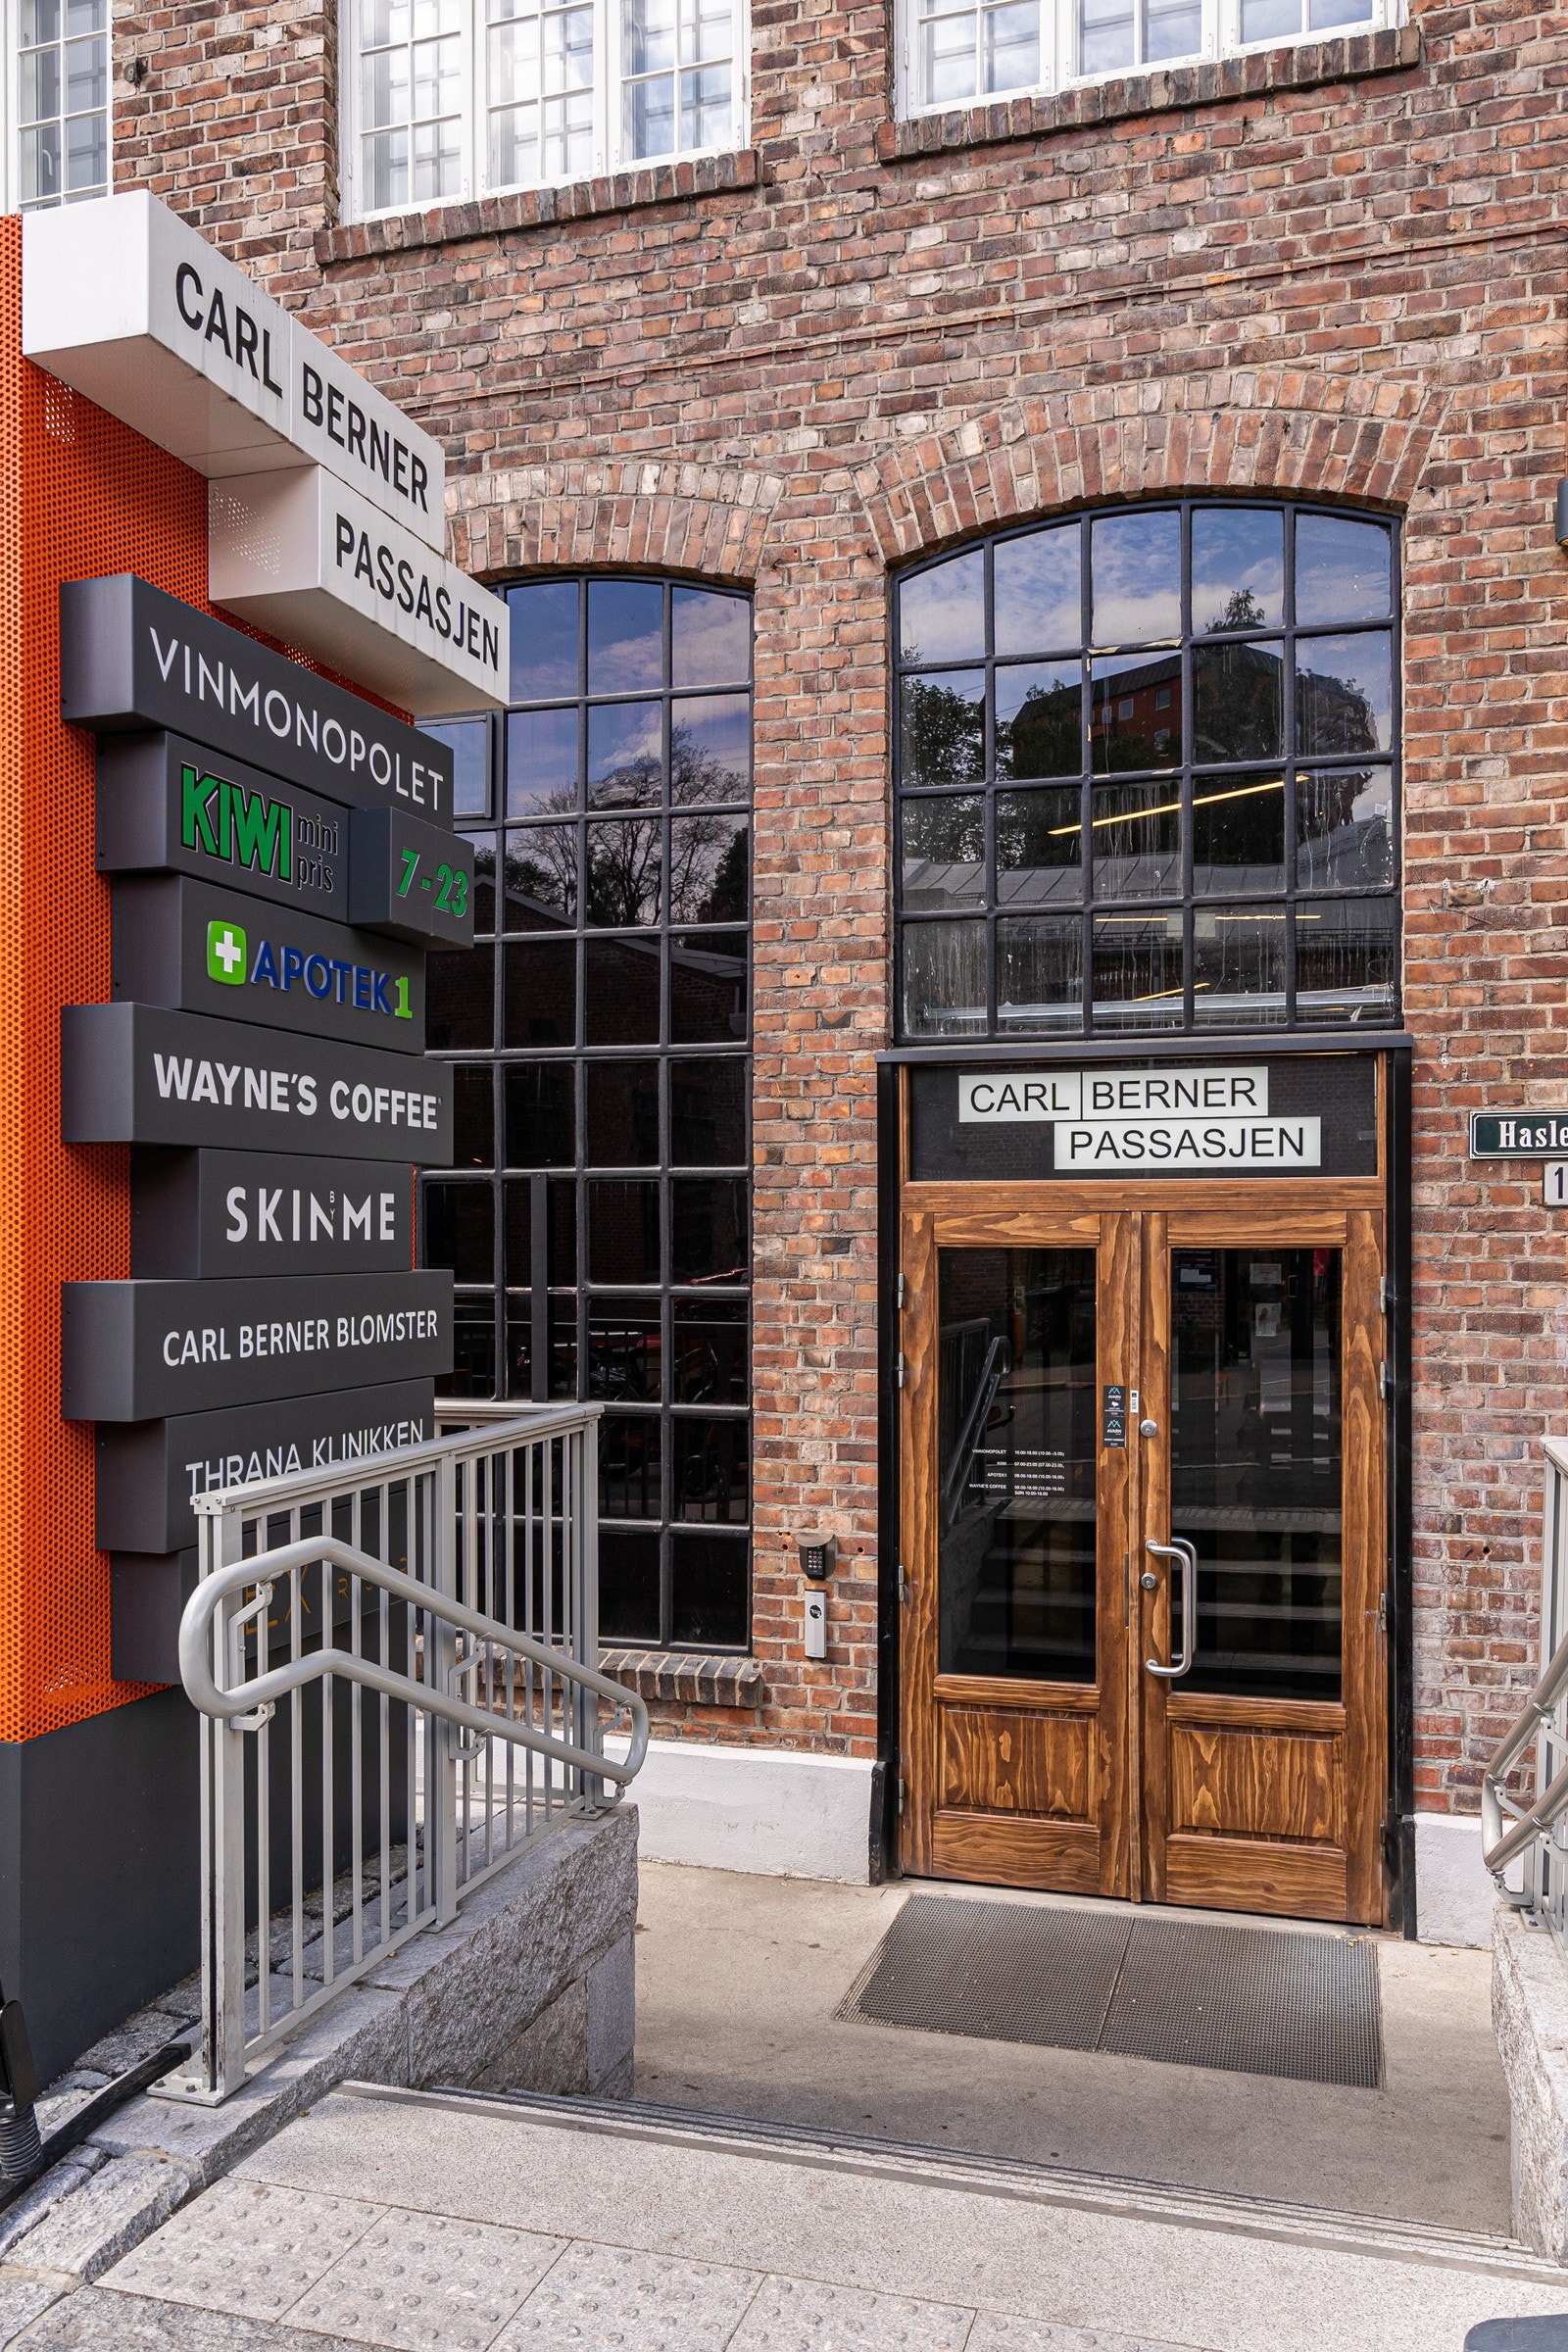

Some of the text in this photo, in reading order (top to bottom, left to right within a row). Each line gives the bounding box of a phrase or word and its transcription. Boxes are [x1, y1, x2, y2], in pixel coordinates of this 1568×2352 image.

[176, 262, 429, 514] CARL BERNER
[336, 513, 499, 671] PASSASJEN
[149, 626, 444, 811] VINMONOPOLET
[181, 761, 293, 884] KIWI
[297, 814, 339, 856] mini
[297, 855, 334, 893] pris
[153, 1053, 438, 1130] WAYNE'S COFFEE
[969, 1077, 1257, 1113] CARL BERNER
[1070, 1127, 1304, 1160] PASSASJEN
[1554, 1166, 1564, 1200] 1
[163, 1309, 438, 1366] CARL BERNER BLOMSTER
[185, 1418, 424, 1496] THRANA KLINIKKEN
